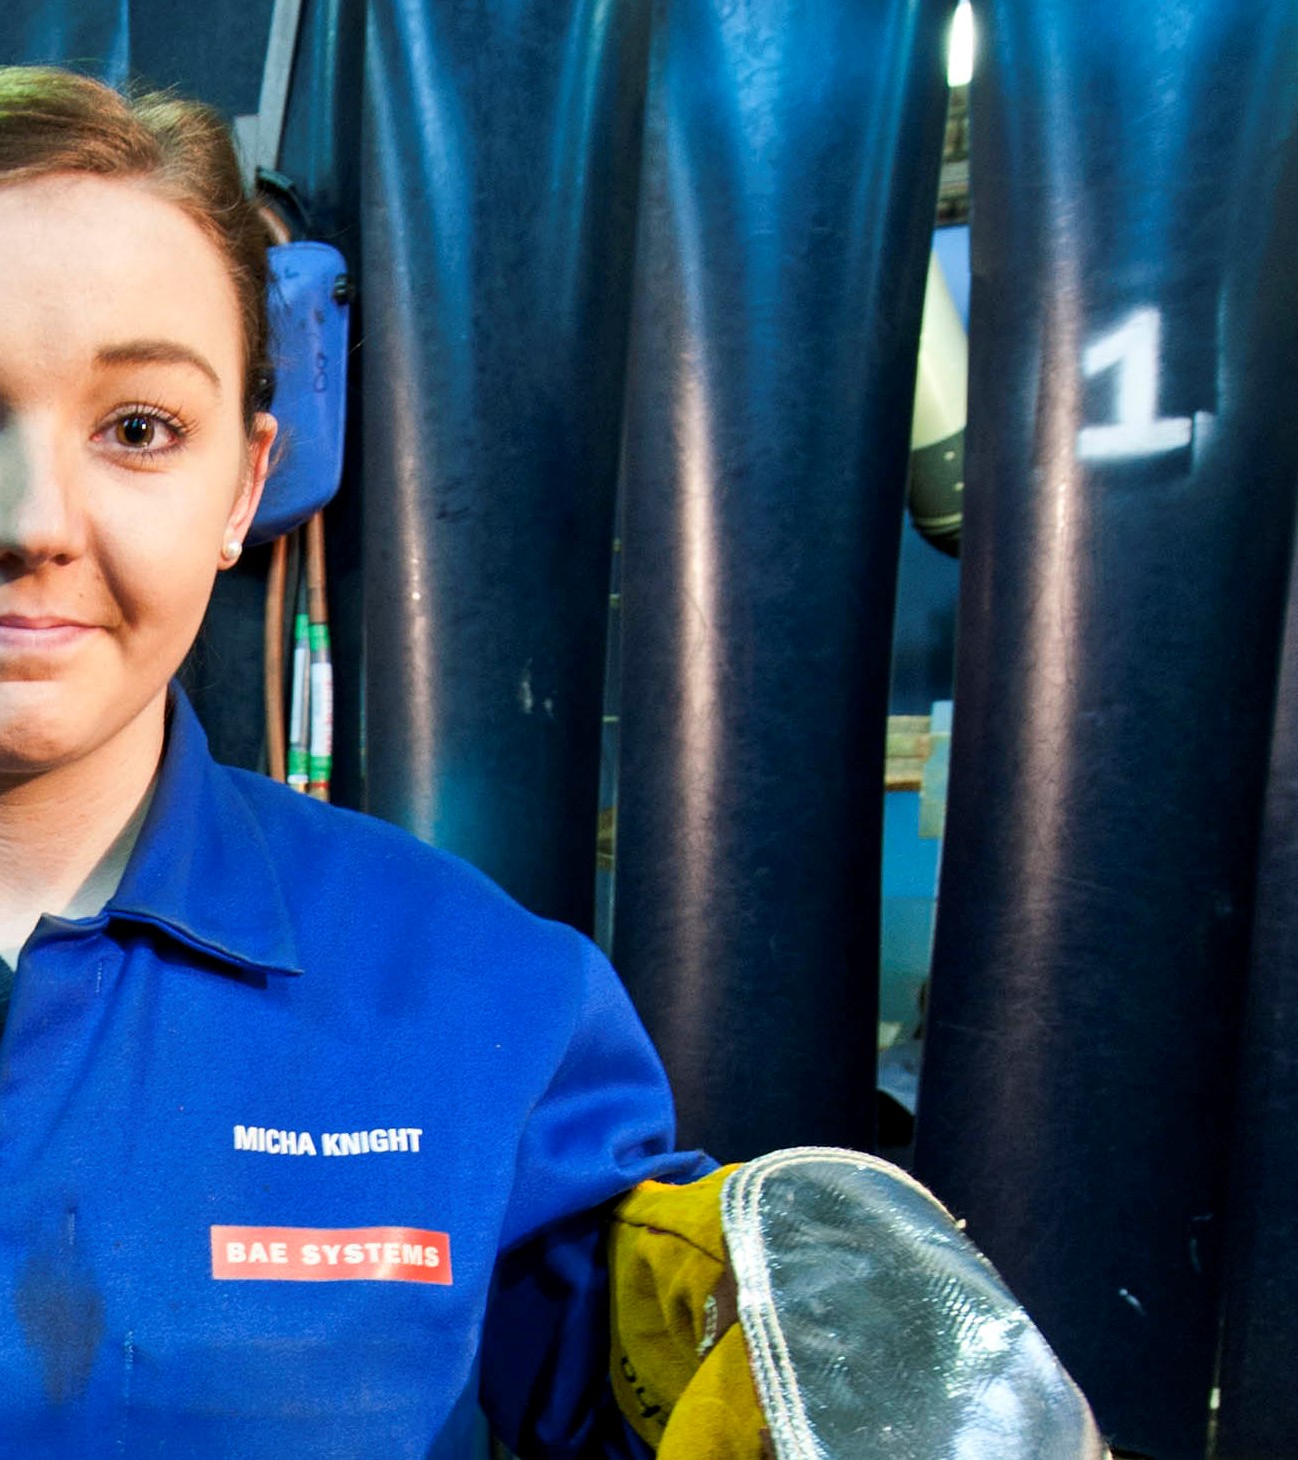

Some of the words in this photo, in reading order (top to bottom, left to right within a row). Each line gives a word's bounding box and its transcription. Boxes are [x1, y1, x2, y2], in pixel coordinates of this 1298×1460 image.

[1077, 306, 1192, 460] 1
[233, 1125, 317, 1156] MICHA
[321, 1128, 423, 1156] KNIGHT
[226, 1242, 289, 1264] BAE
[302, 1242, 440, 1268] SYSTEMS
